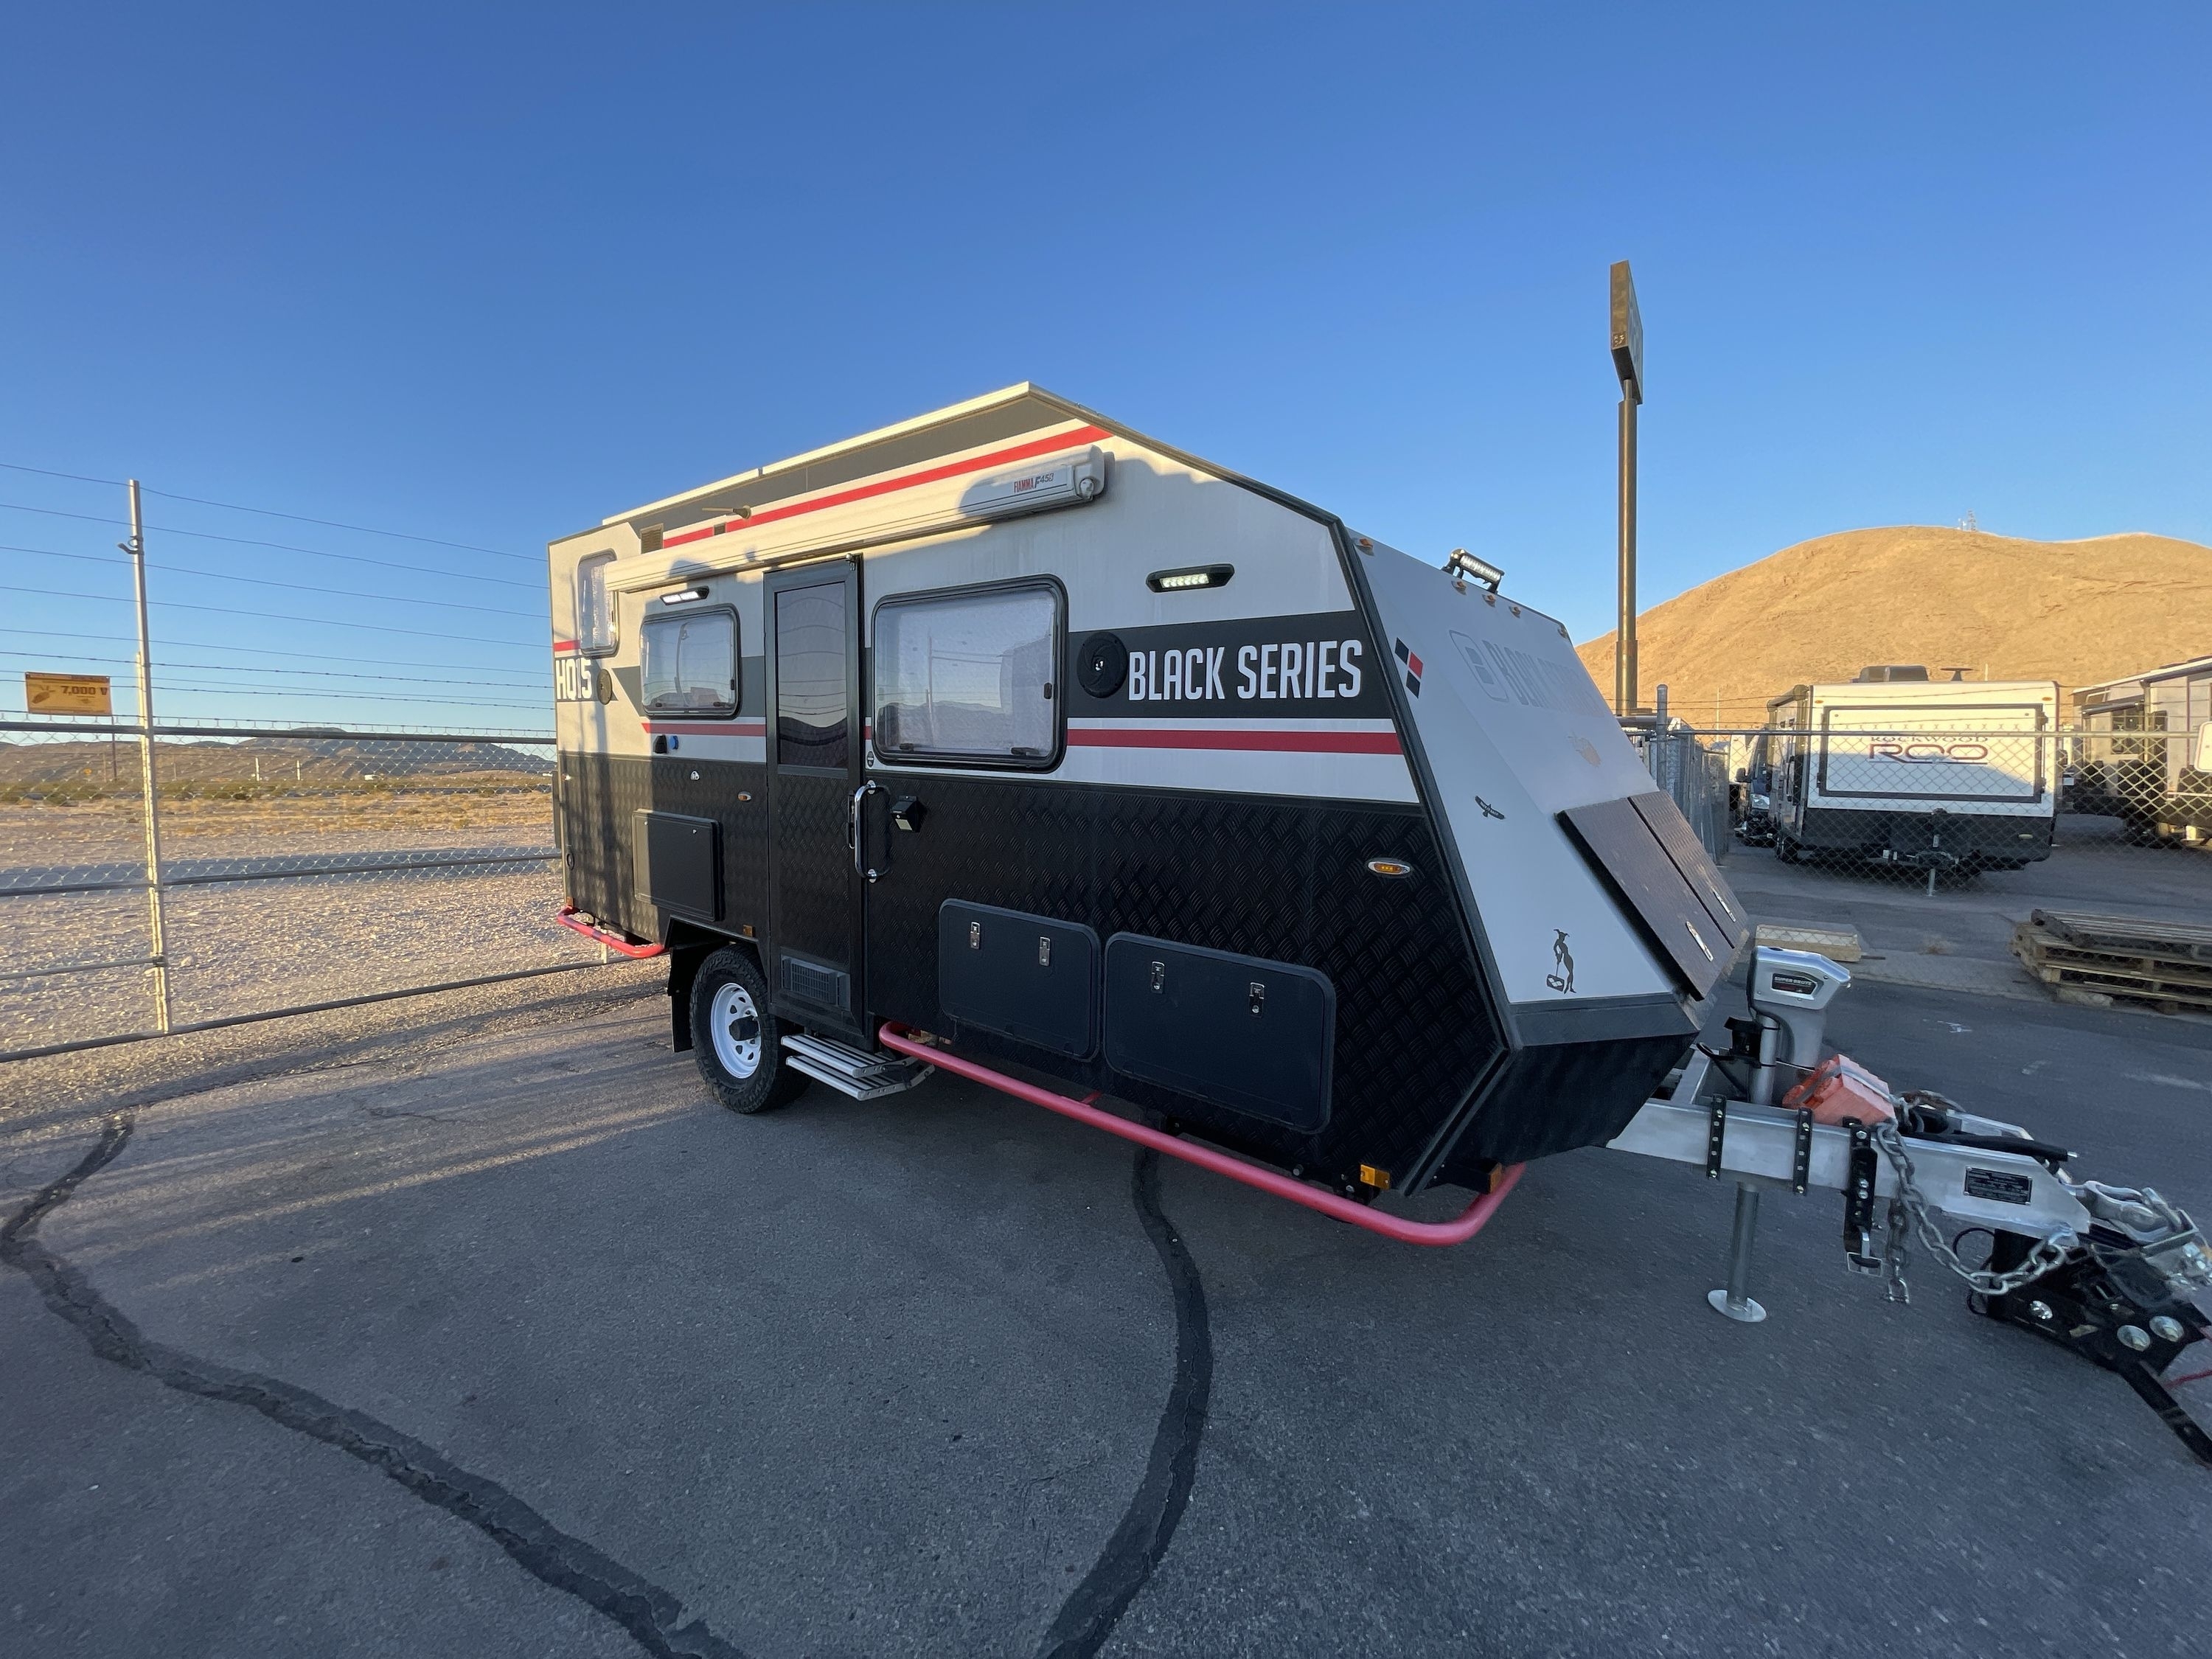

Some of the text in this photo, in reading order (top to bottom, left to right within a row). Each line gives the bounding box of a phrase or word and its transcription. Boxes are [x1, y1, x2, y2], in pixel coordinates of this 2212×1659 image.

[1014, 478, 1034, 493] FIAMMA
[1129, 639, 1363, 700] BLACK SERIES
[60, 685, 97, 696] 7,000
[1869, 744, 1989, 763] ROO
